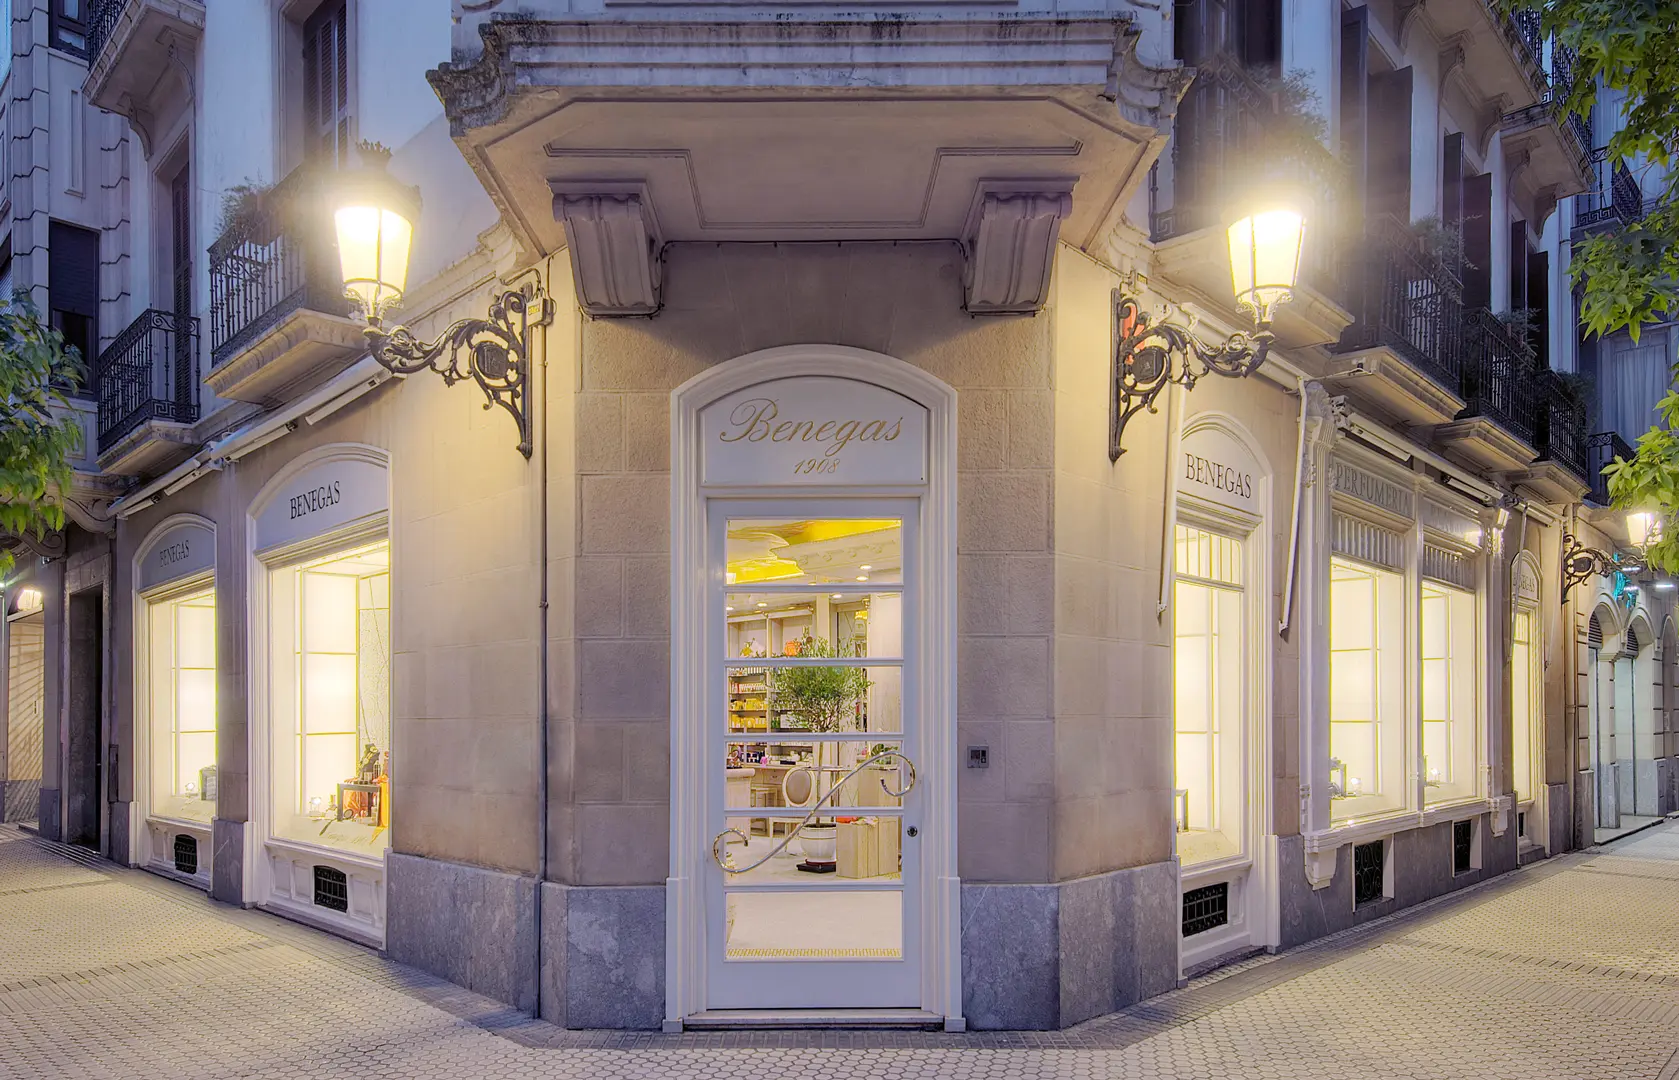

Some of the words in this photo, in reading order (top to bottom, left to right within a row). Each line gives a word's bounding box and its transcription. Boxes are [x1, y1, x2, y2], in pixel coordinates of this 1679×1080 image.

[720, 397, 903, 457] Benegas
[794, 458, 841, 474] 1908
[1185, 453, 1252, 499] BENEGAS
[289, 480, 341, 520] BENEGAS
[159, 539, 190, 568] BENEGAS
